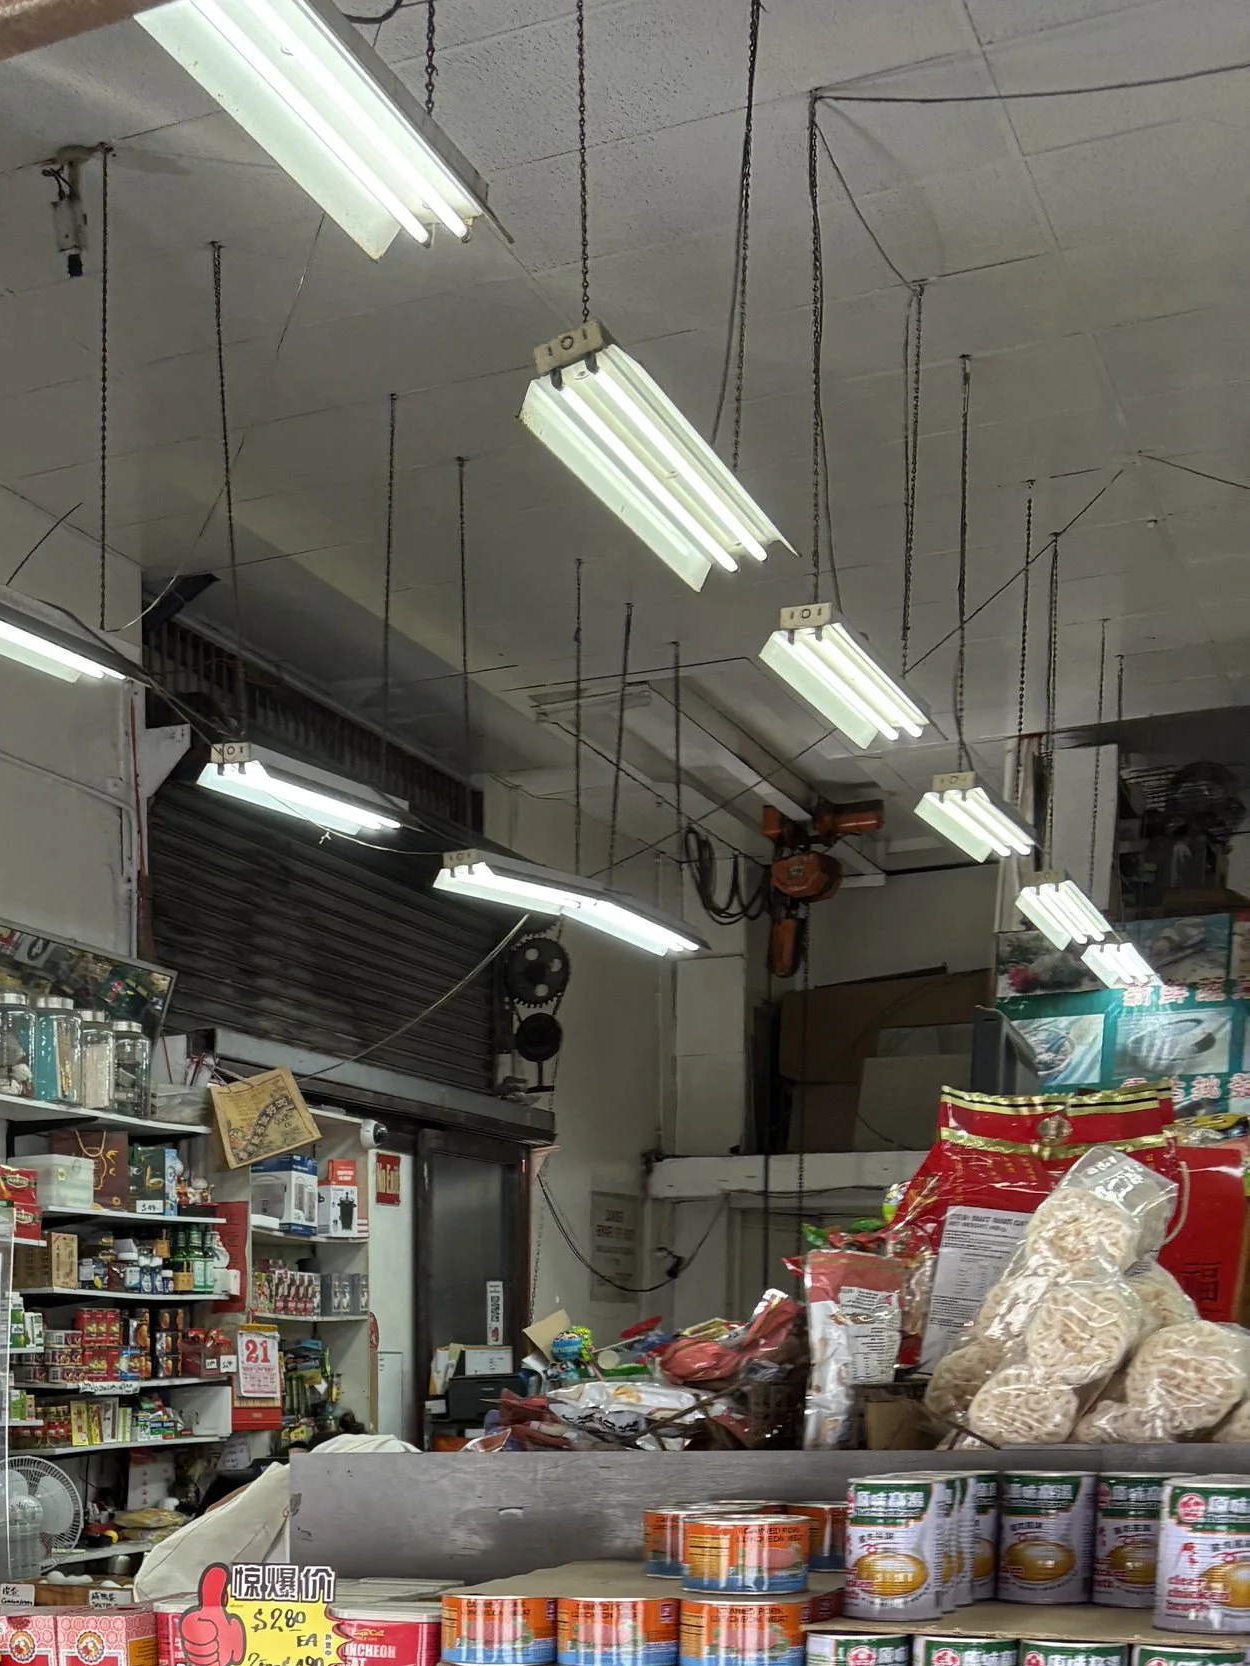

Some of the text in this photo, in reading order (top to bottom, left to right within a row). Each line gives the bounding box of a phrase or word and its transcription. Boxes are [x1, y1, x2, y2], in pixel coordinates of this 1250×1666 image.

[245, 1339, 270, 1364] 21
[232, 1564, 335, 1602] 惊爆价
